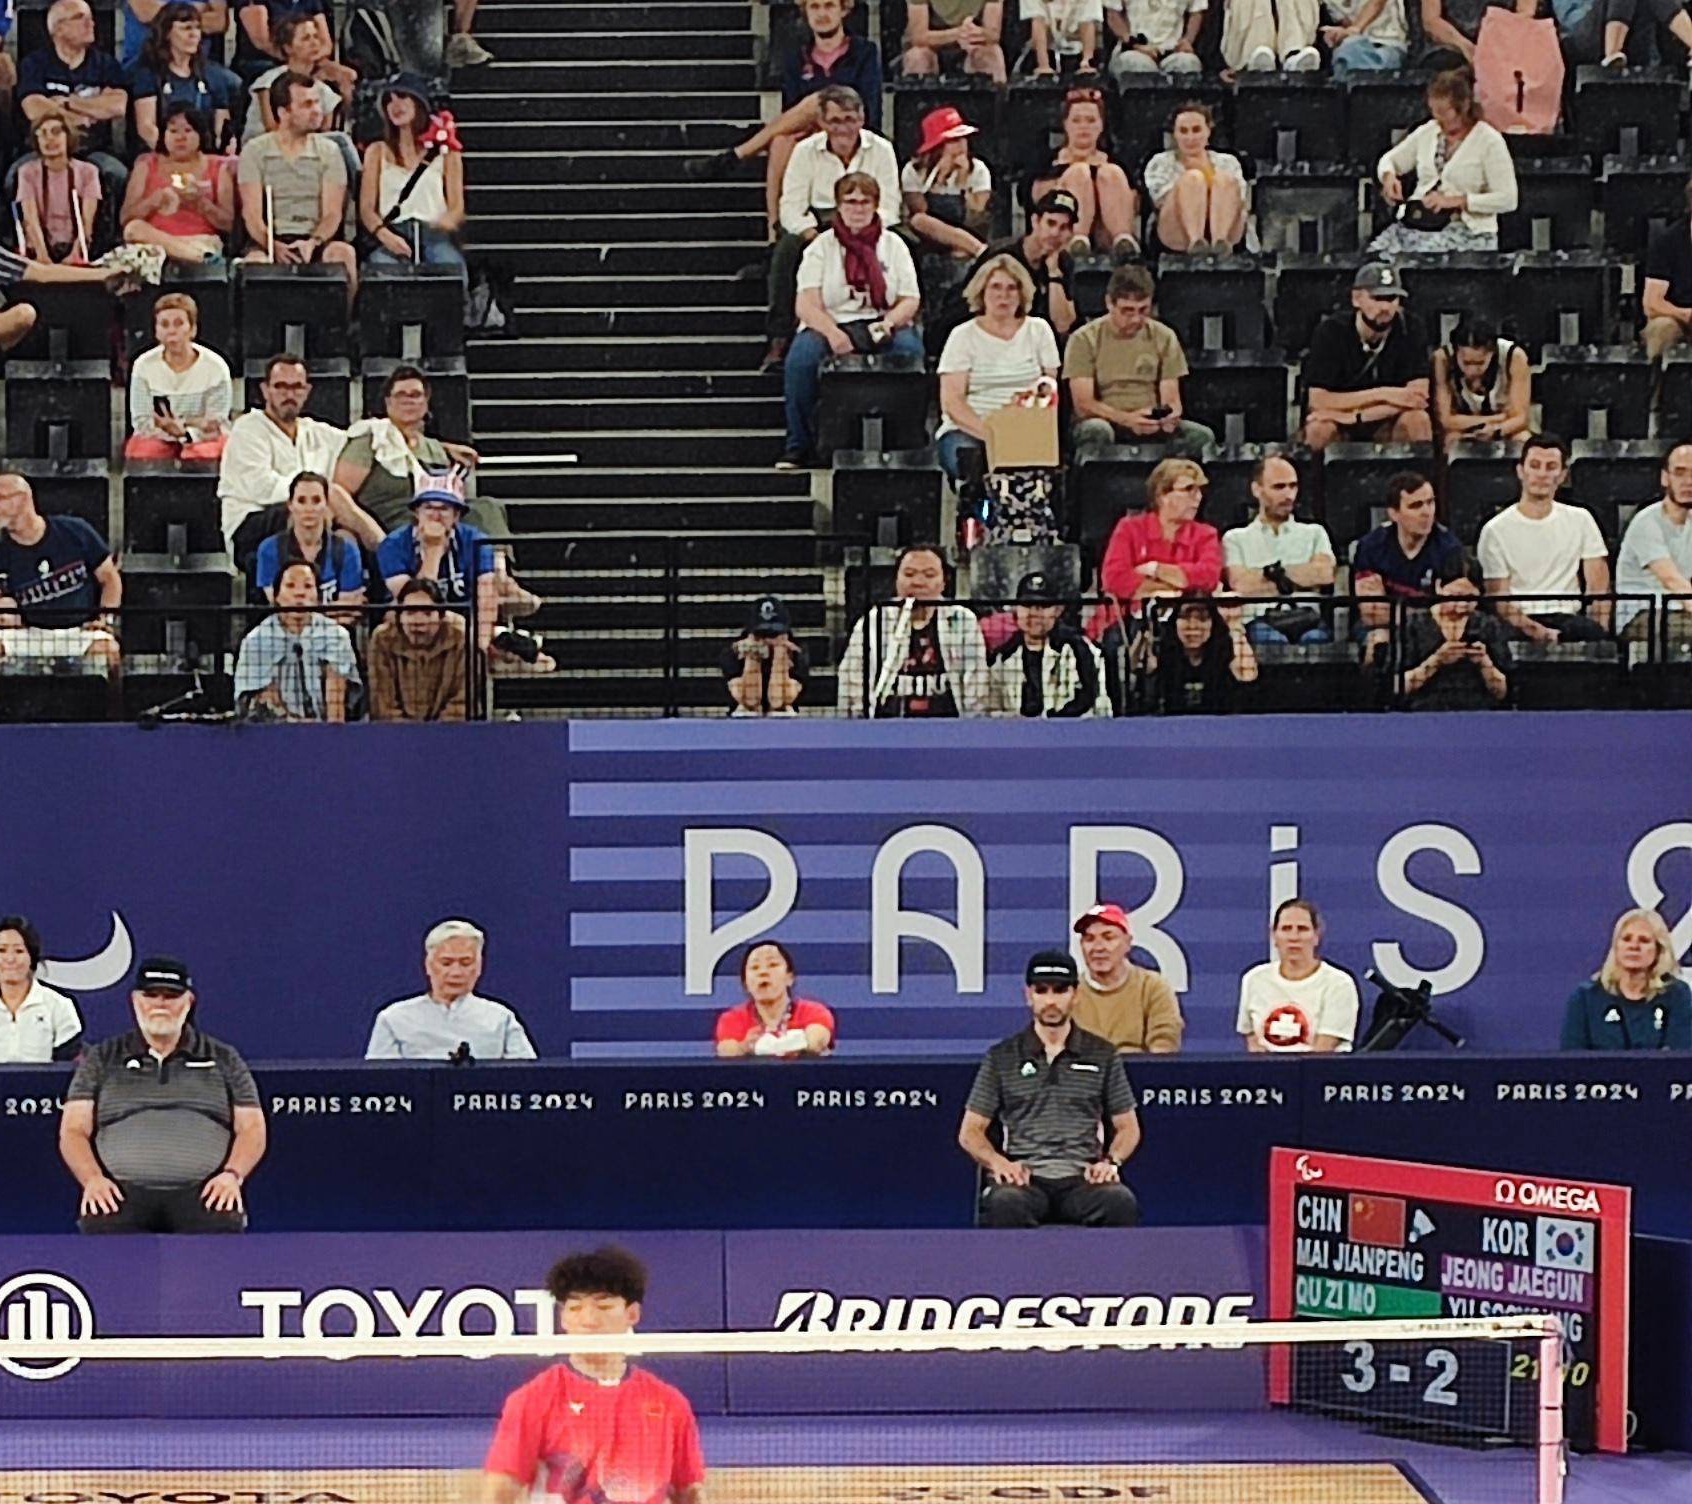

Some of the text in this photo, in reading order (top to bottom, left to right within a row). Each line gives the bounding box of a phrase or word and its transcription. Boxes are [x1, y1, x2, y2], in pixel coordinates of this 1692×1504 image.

[349, 1095, 413, 1113] 2024
[529, 1093, 594, 1110] 2024
[702, 1091, 765, 1108] 2024
[873, 1089, 938, 1107] 2024
[1220, 1088, 1284, 1105] 2024
[1401, 1084, 1466, 1102] 2024
[1574, 1083, 1639, 1101] 2024
[1297, 1195, 1342, 1233] CHN
[1517, 1182, 1602, 1214] OMEGA
[1482, 1216, 1530, 1257] KOR
[1296, 1237, 1425, 1282] MAI JIANPENG
[1440, 1256, 1585, 1303] JEONG JAEGUN
[1348, 1280, 1377, 1315] MO
[241, 1287, 556, 1359] TOYOT
[774, 1292, 1254, 1351] BRIDGESTONE
[1341, 1340, 1376, 1392] 3
[1423, 1348, 1459, 1406] 2
